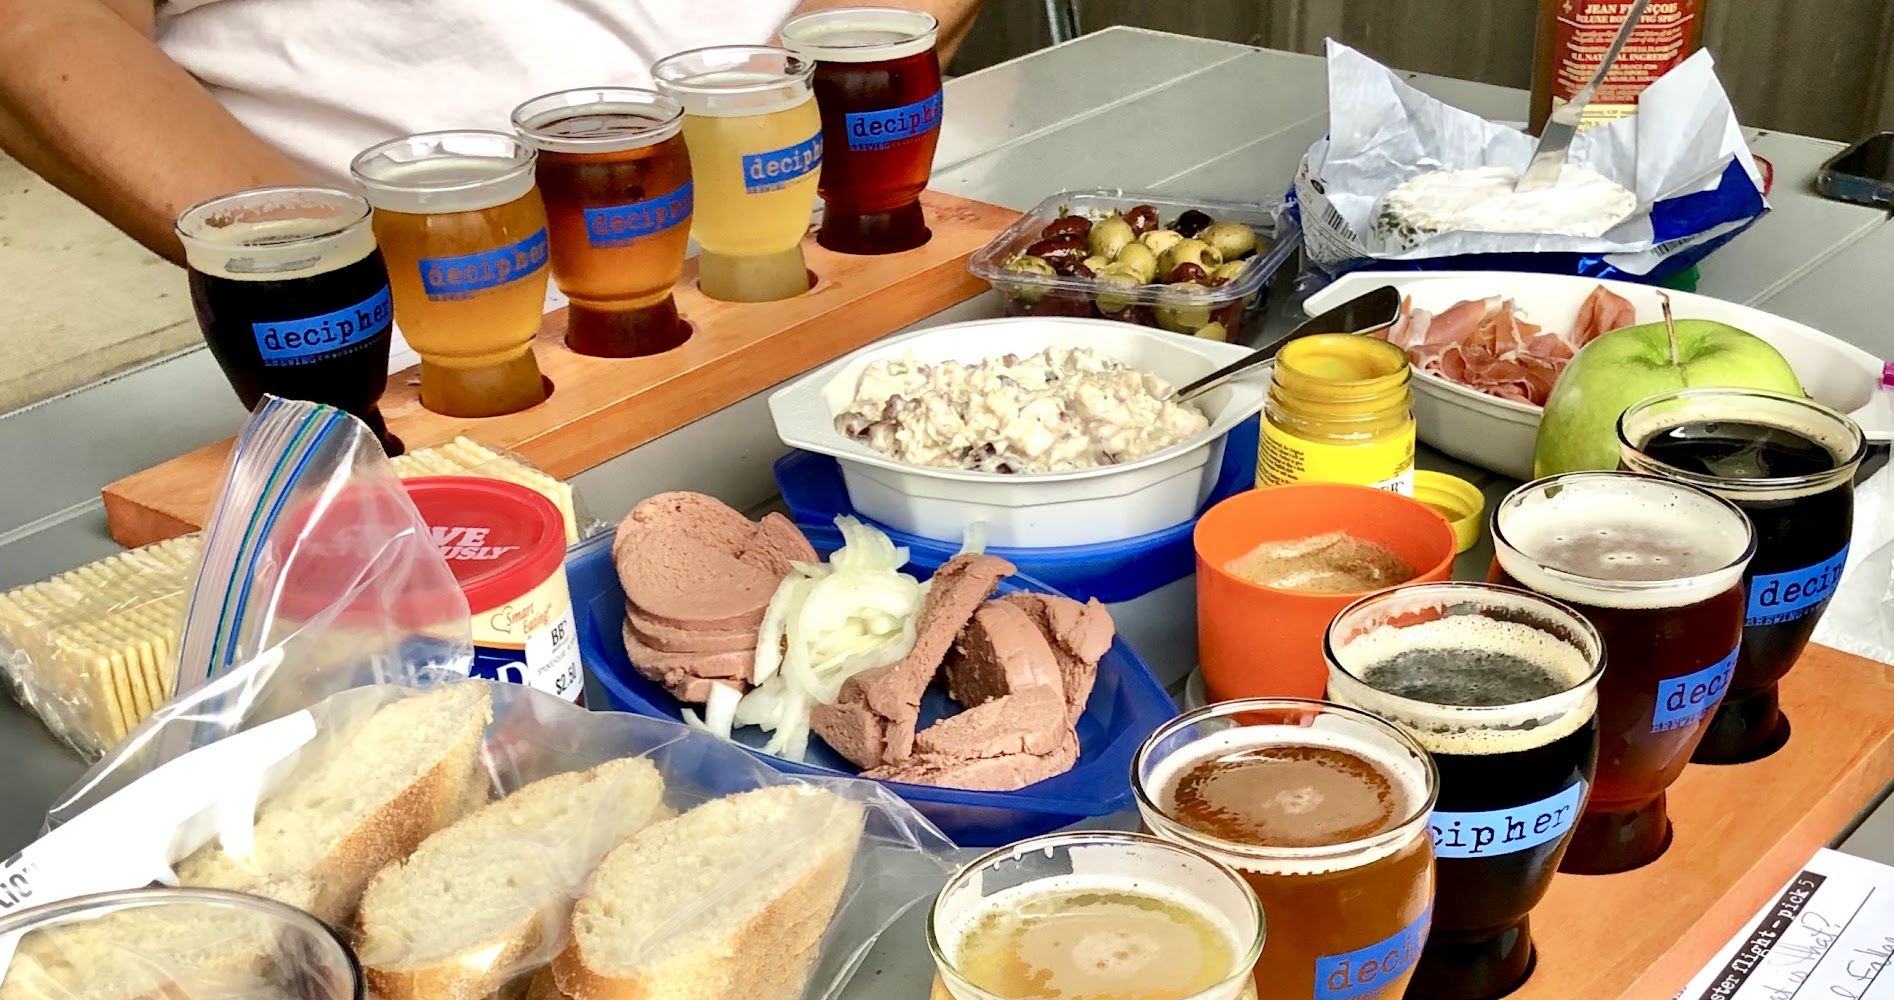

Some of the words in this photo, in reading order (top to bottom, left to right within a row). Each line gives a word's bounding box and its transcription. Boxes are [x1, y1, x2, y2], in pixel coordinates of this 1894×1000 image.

[1584, 4, 1617, 14] JEAN
[1619, 3, 1678, 15] FNÇOIS
[428, 242, 546, 287] decipher
[264, 300, 388, 350] decipher
[1759, 562, 1843, 607] decip
[506, 602, 534, 626] Smart
[1667, 660, 1731, 712] deci
[1432, 803, 1571, 854] cipher
[1731, 930, 1776, 973] flight
[1778, 888, 1810, 920] pick
[1799, 878, 1815, 889] 5
[1327, 932, 1414, 992] deci
